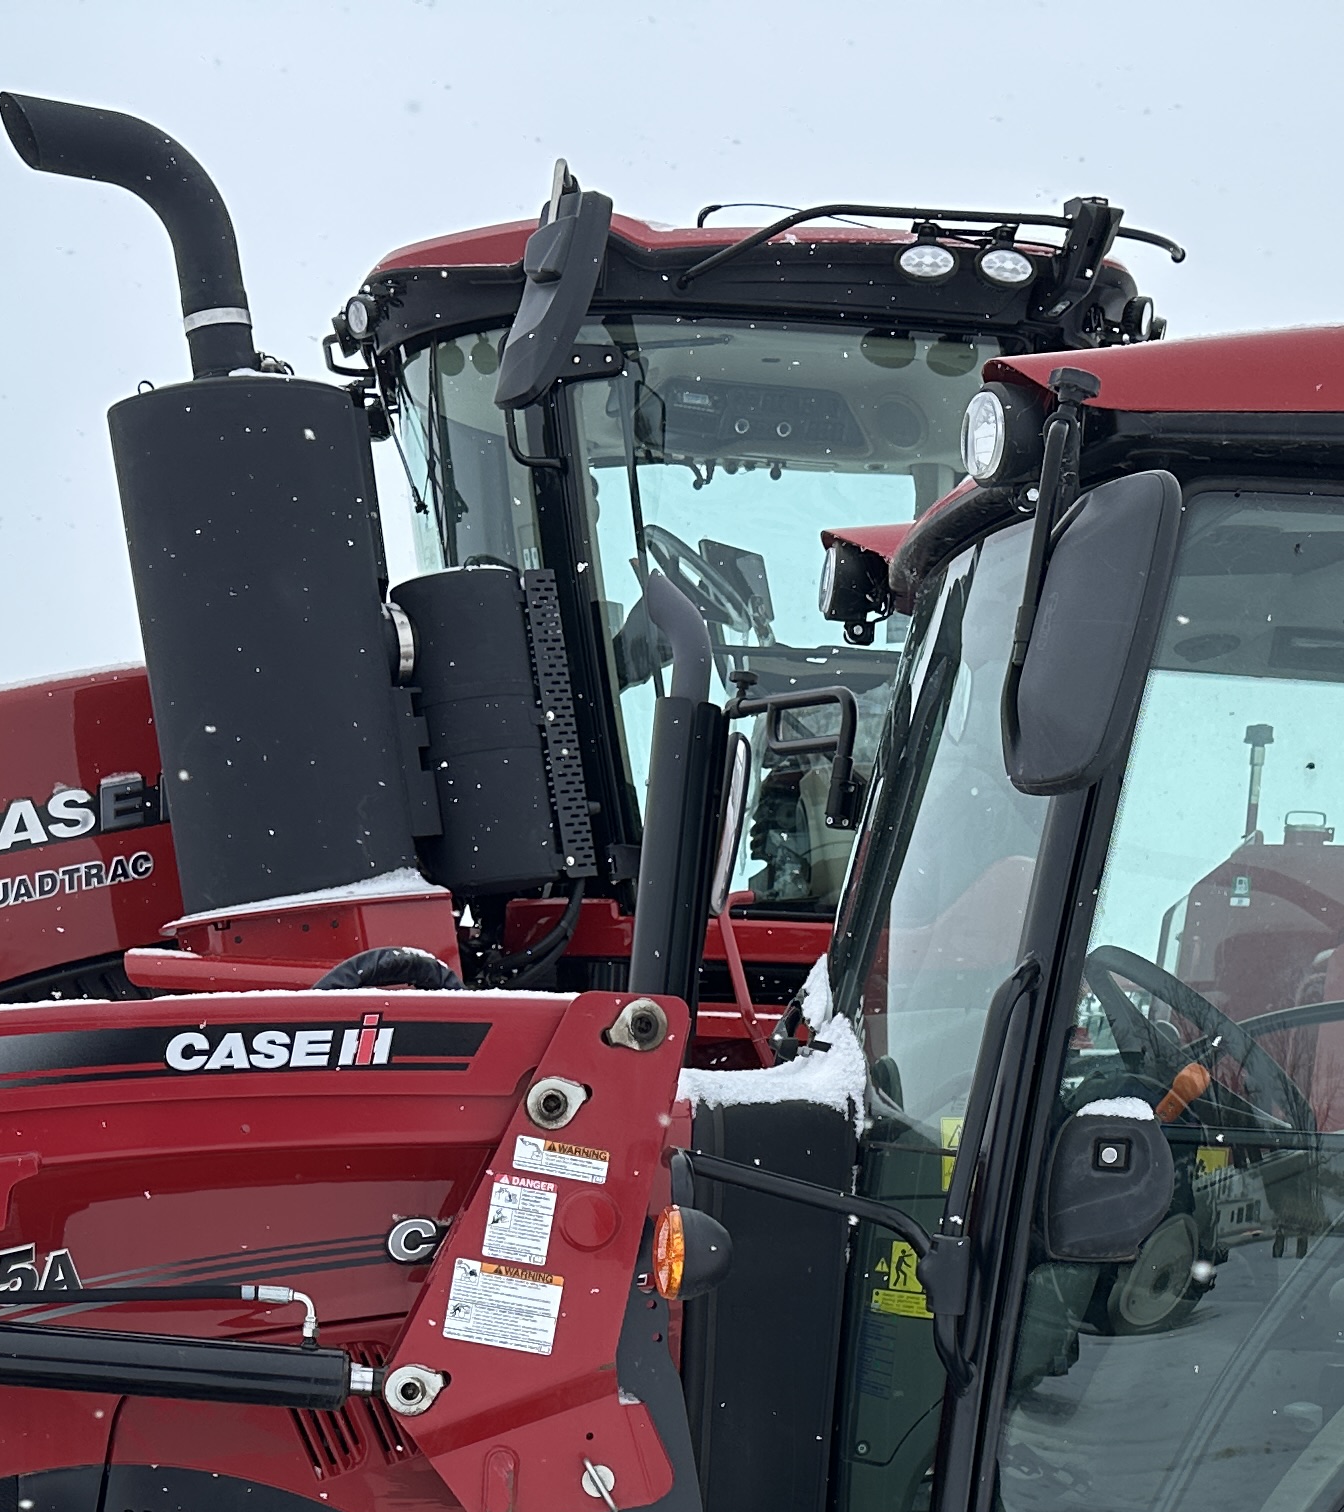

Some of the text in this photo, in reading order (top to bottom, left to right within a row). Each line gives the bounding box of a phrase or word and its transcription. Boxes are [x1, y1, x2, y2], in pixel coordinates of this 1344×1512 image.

[165, 1014, 395, 1071] CASE IH
[557, 1142, 608, 1161] WARNING
[511, 1176, 555, 1192] DANGER
[505, 1265, 554, 1284] WARNING
